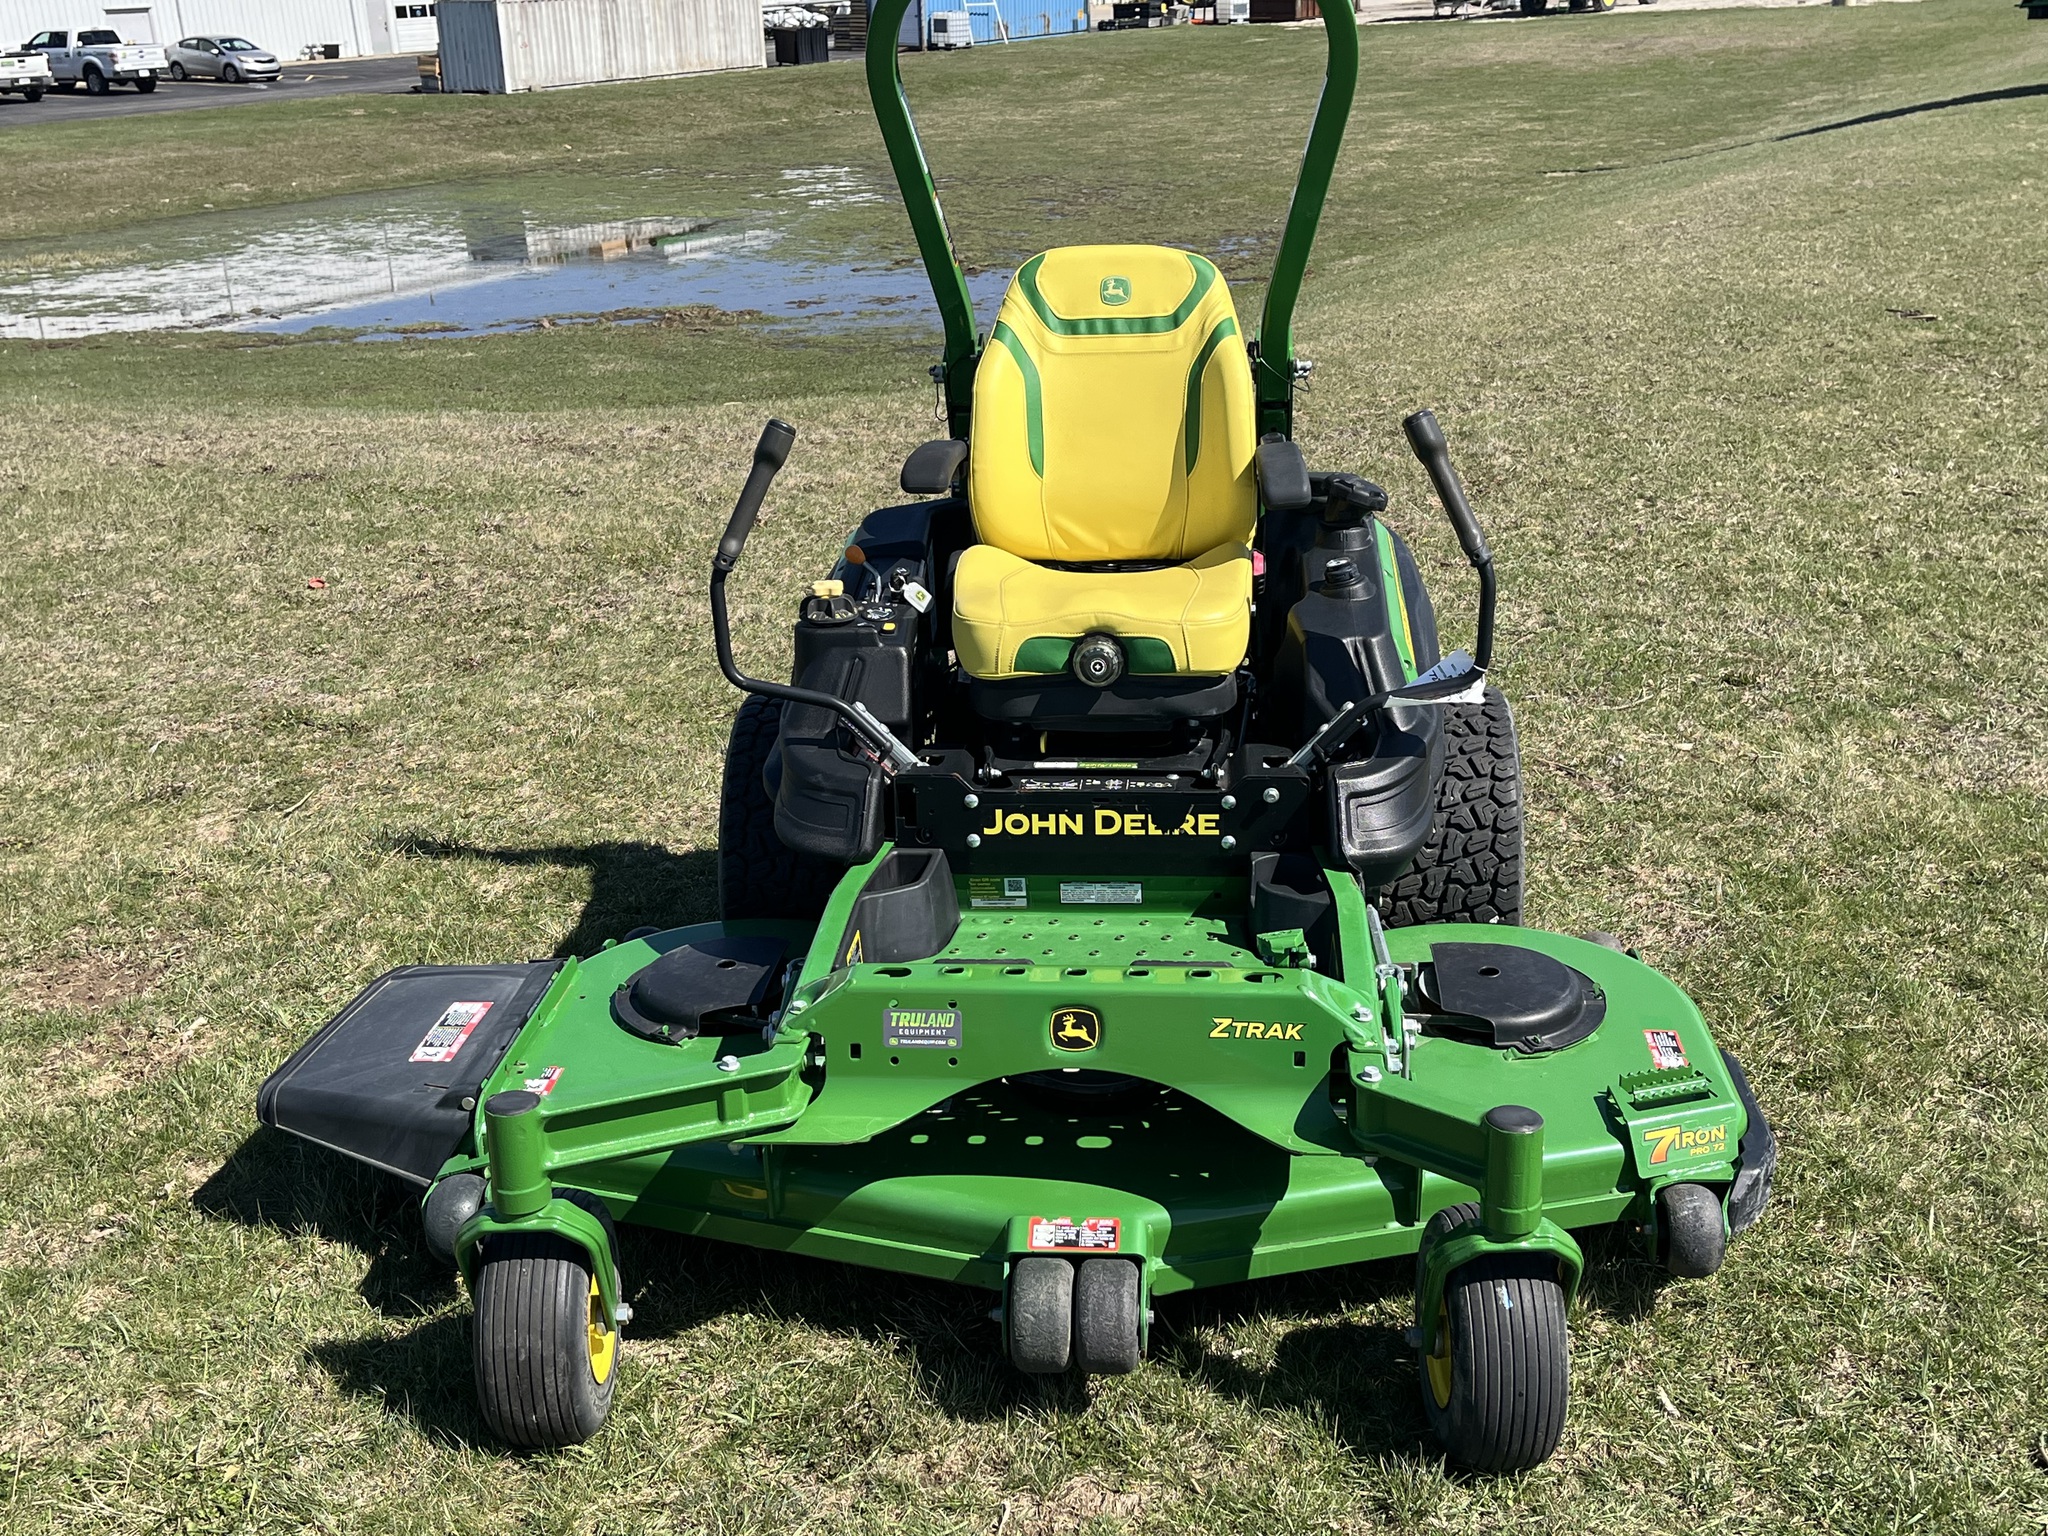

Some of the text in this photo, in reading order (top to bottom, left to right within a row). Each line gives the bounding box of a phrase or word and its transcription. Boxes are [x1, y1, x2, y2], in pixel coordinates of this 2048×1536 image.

[983, 808, 1083, 835] JOHN
[890, 1012, 956, 1028] TRULAND
[898, 1028, 947, 1036] EQUIPMENT
[1209, 1017, 1306, 1040] ZTRAK
[1689, 1142, 1725, 1157] PRO 72
